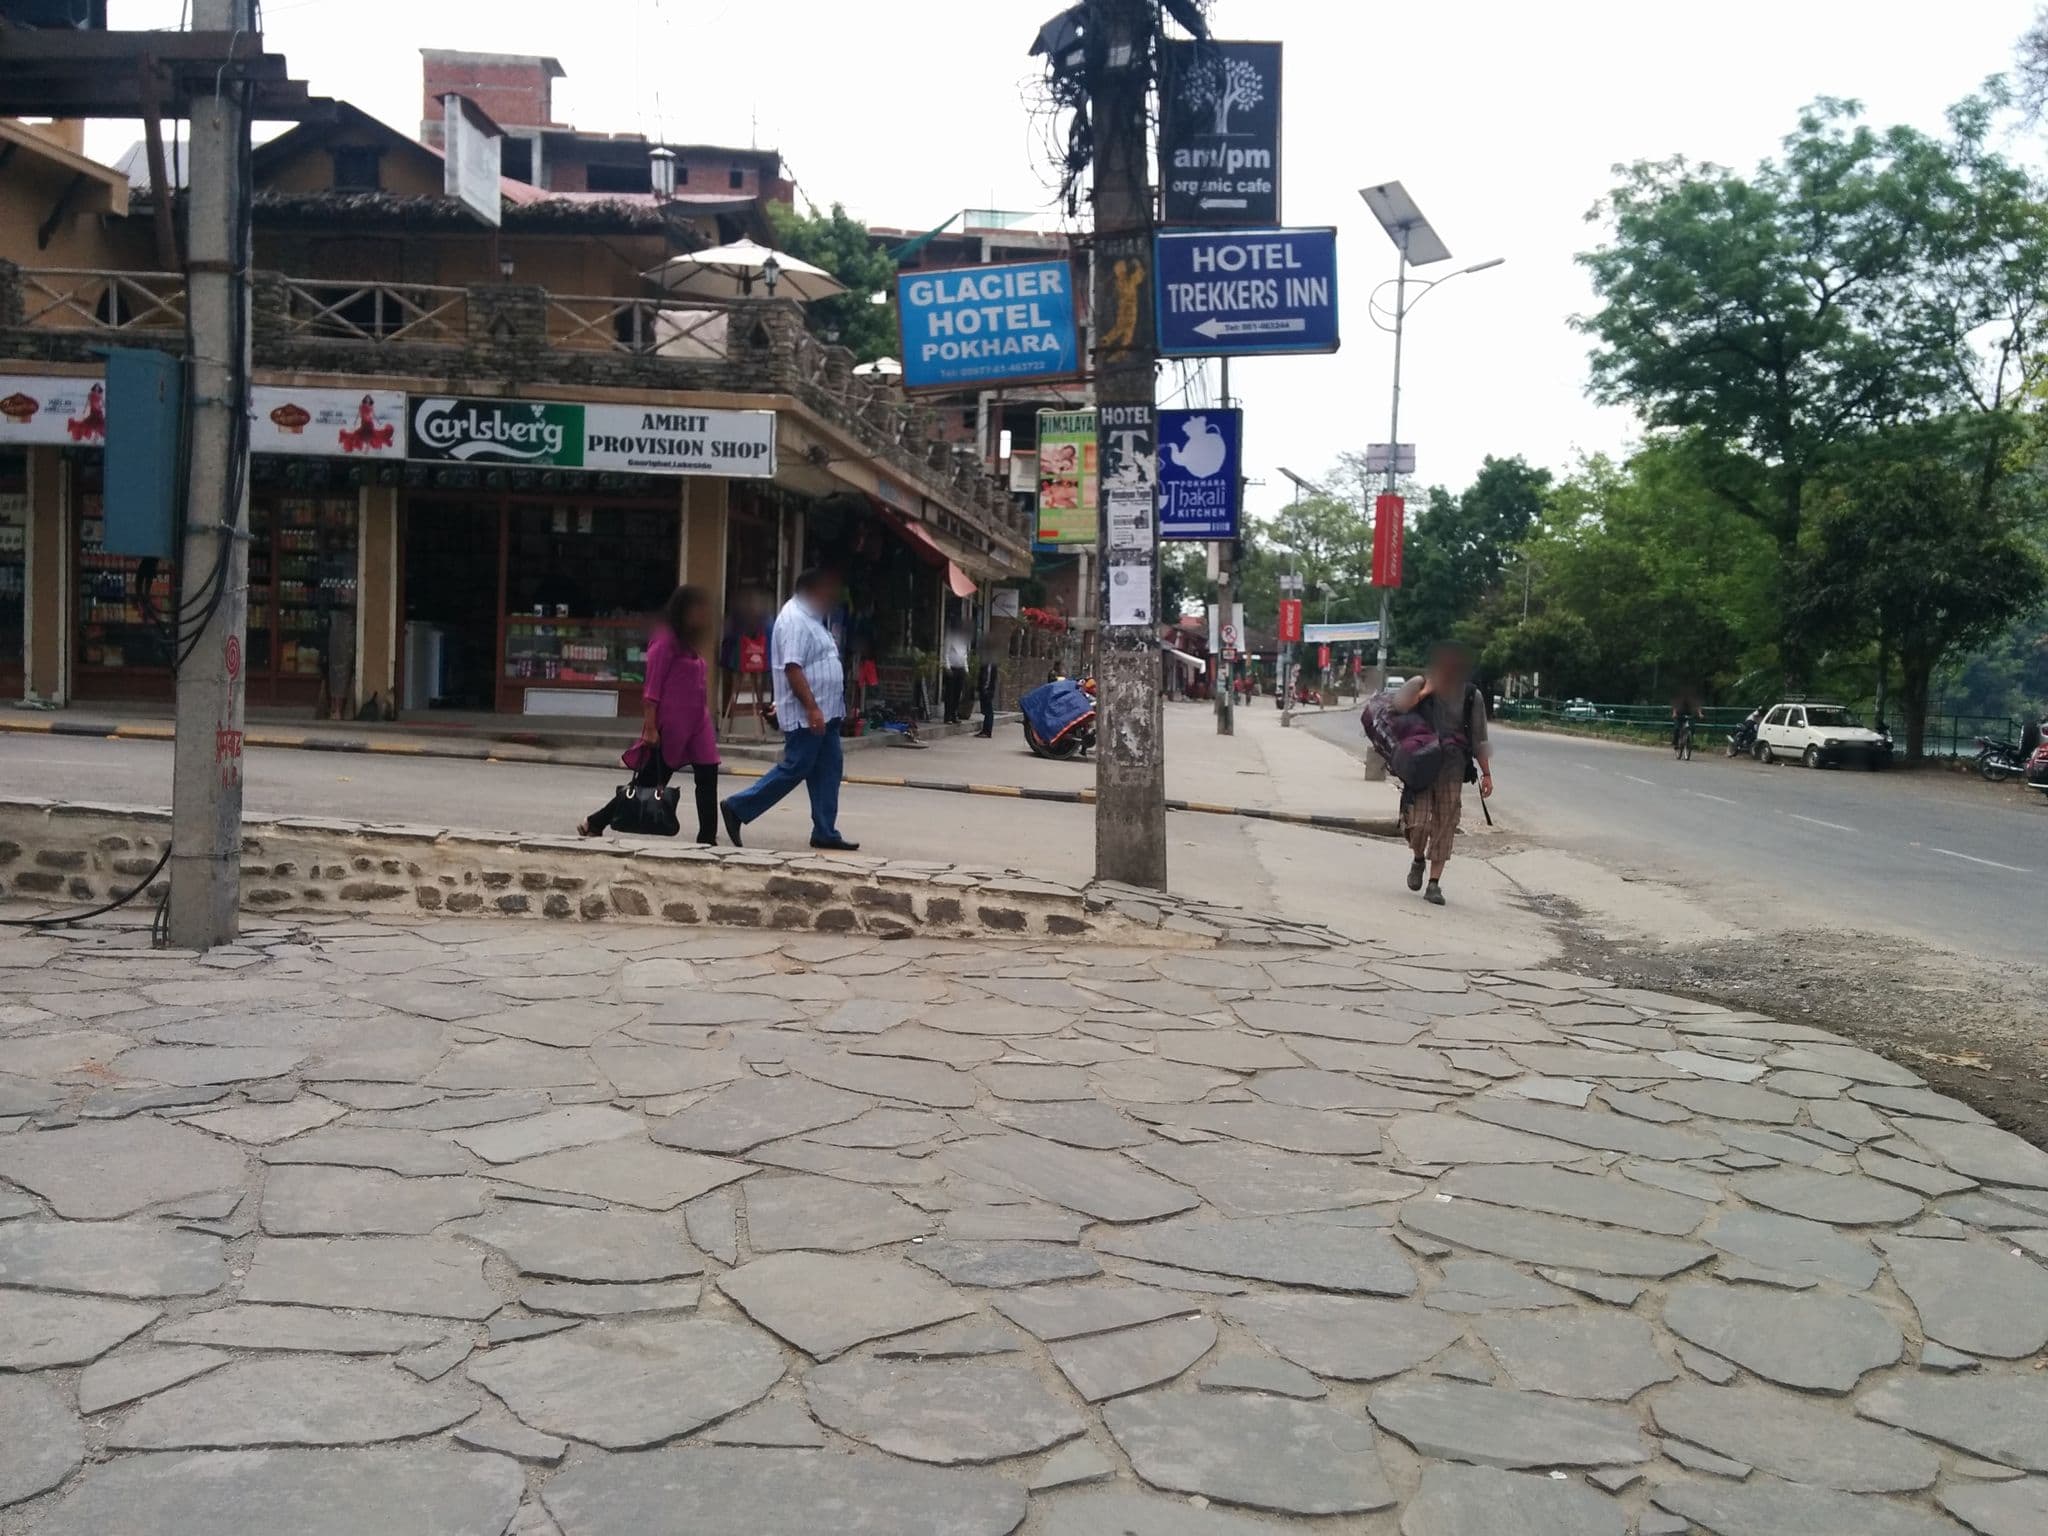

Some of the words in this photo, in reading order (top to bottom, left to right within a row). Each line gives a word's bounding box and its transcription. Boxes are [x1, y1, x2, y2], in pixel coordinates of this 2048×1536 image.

[1174, 142, 1271, 174] am/pm
[1236, 177, 1273, 194] cafe
[1192, 243, 1302, 272] HOTEL
[908, 269, 1064, 307] GLACIER
[1167, 279, 1280, 313] TREKKERS
[1286, 276, 1329, 308] INN
[927, 302, 1052, 338] HOTEL
[921, 332, 1061, 363] POKHARA
[415, 399, 564, 454] Carlsberg
[640, 413, 710, 433] AMRIT
[1041, 415, 1097, 434] HIMALAYA
[1101, 406, 1152, 425] HOTEL
[588, 434, 704, 457] PROVISION
[711, 440, 768, 459] SHOP
[1180, 479, 1226, 488] POKHARA
[1167, 481, 1226, 516] Thakali
[1177, 508, 1226, 518] KITCHEN
